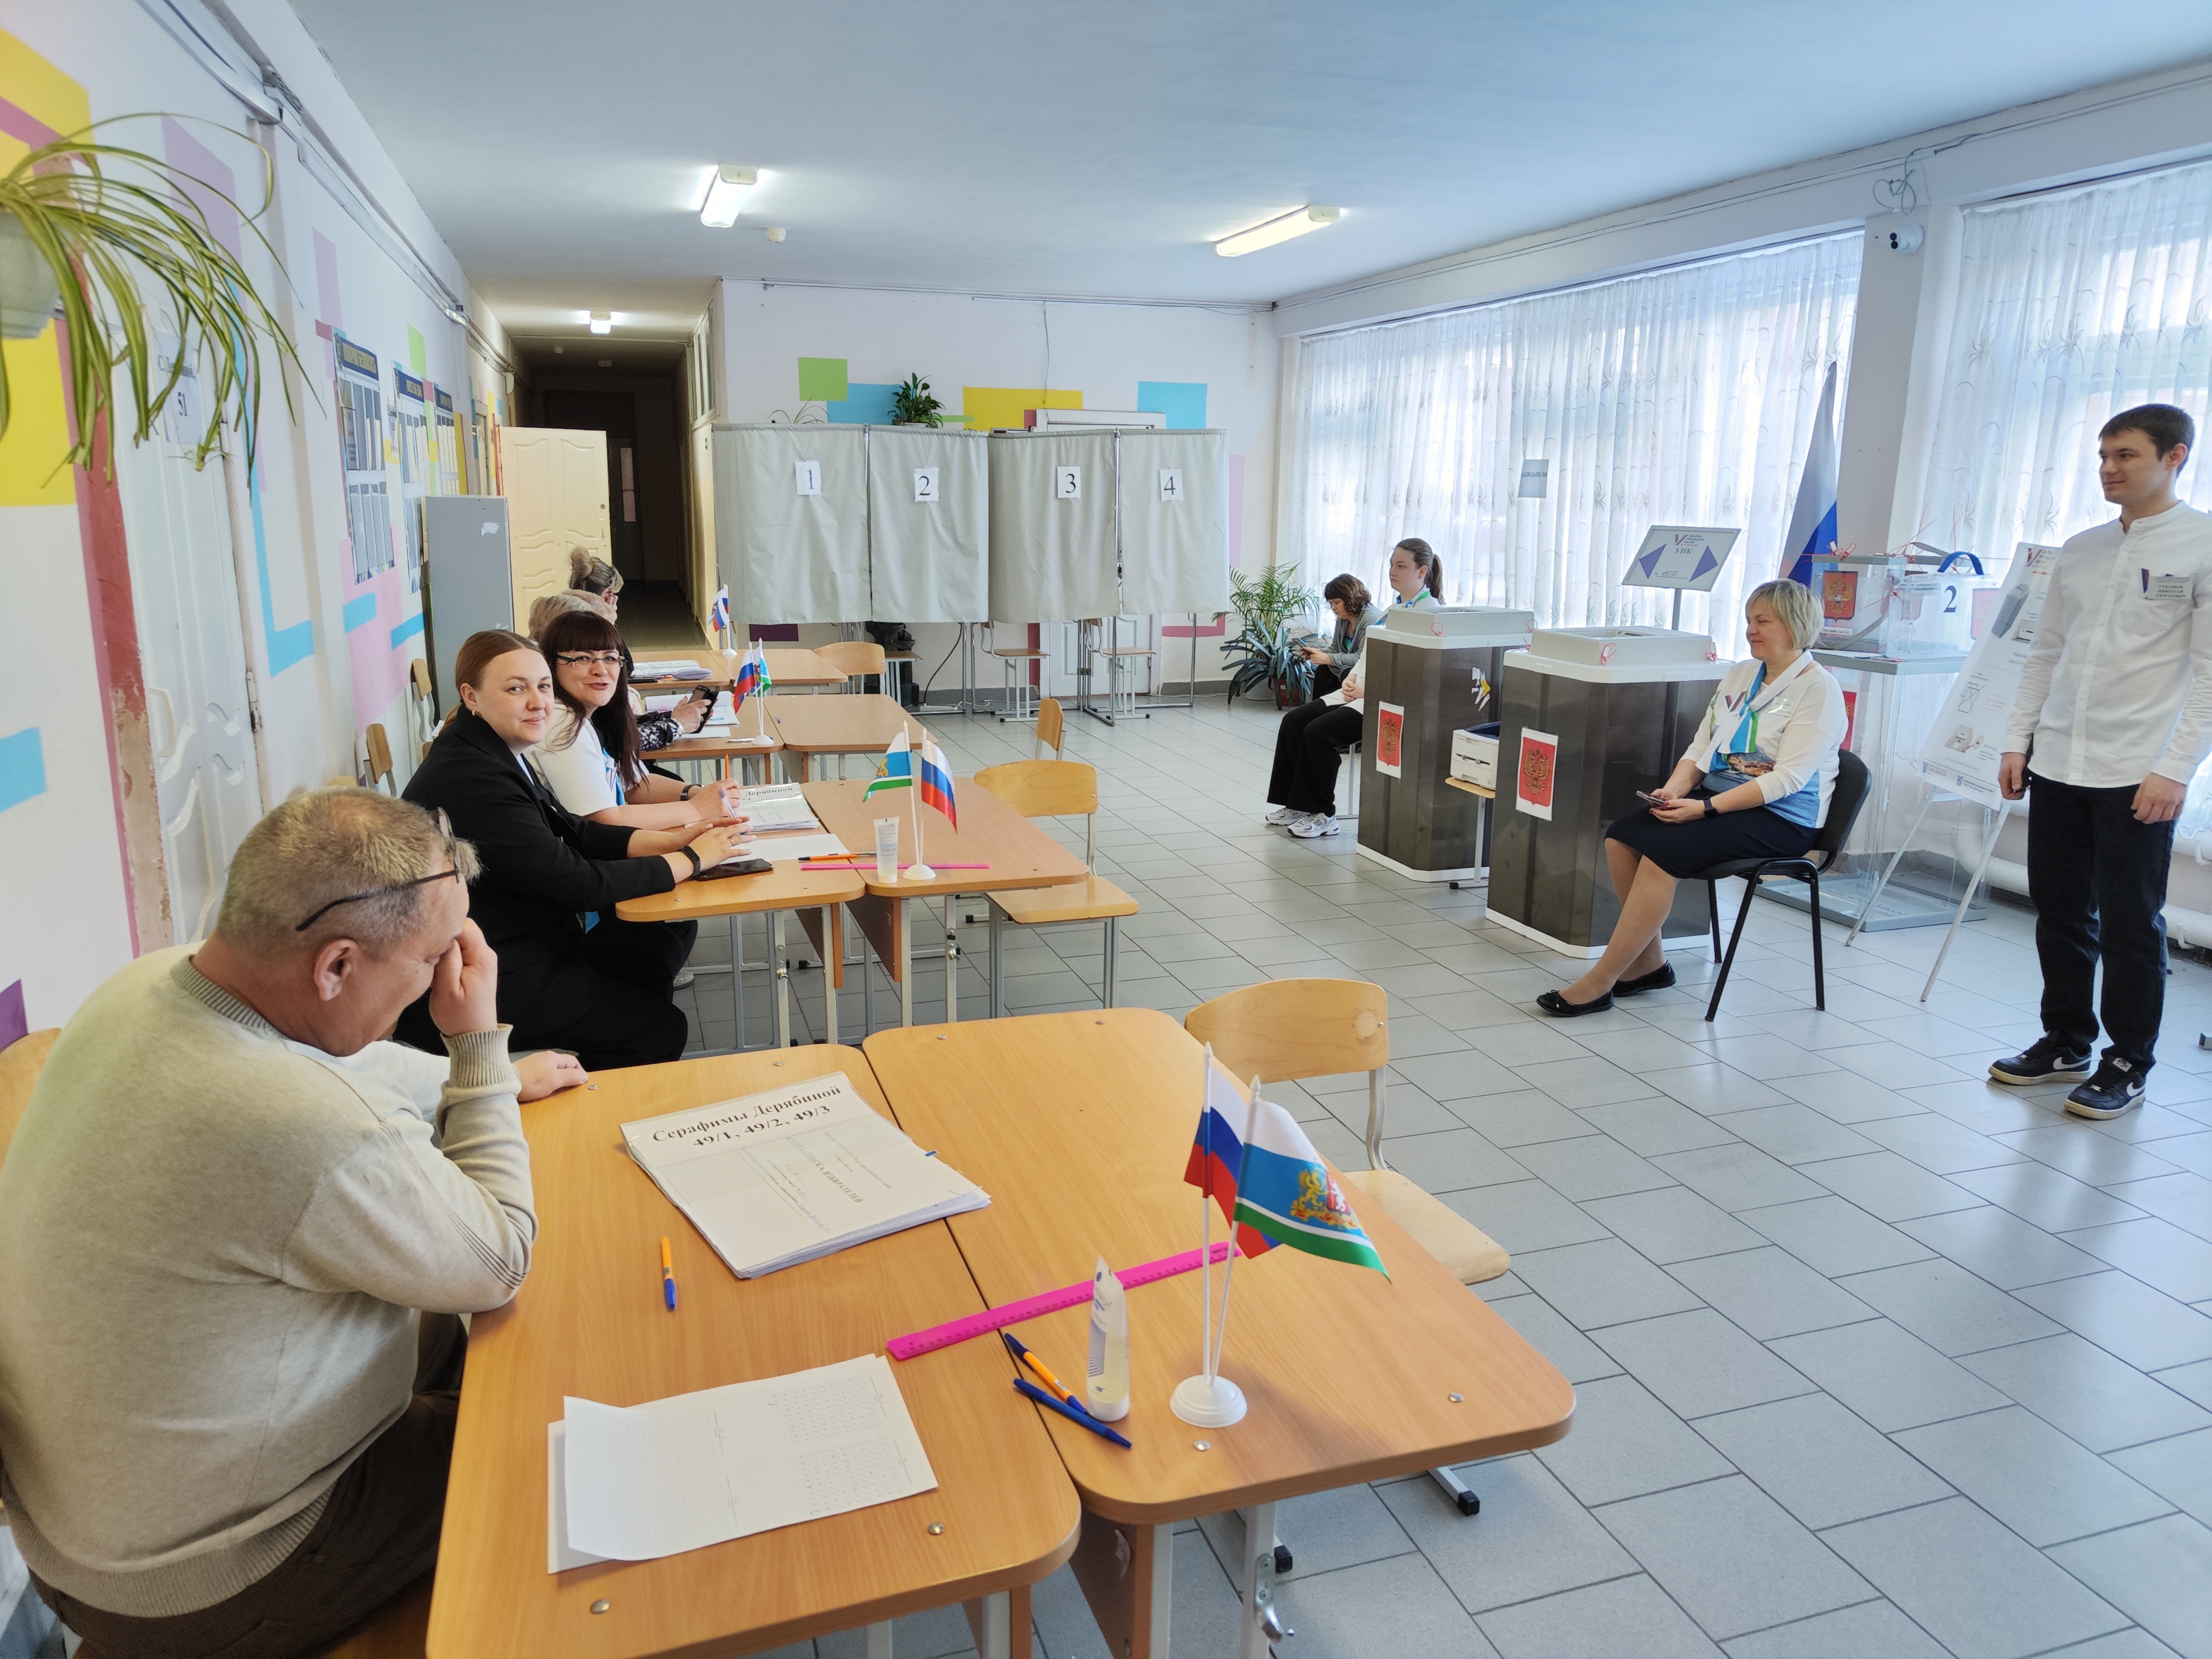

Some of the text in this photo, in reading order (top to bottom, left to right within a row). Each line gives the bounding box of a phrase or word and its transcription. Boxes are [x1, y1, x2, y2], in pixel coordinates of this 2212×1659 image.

[806, 469, 815, 490] 1
[918, 475, 931, 496] 2
[1065, 473, 1076, 494] 3
[1163, 476, 1176, 495] 4
[1943, 585, 1958, 613] 2
[745, 787, 793, 797] Дерябиной
[652, 1085, 842, 1142] Серафимы Дерябиной
[693, 1105, 831, 1147] 49/1, 49/2, 49/3
[822, 1170, 865, 1203] ИЗБИРАТЕЛЕЙ
